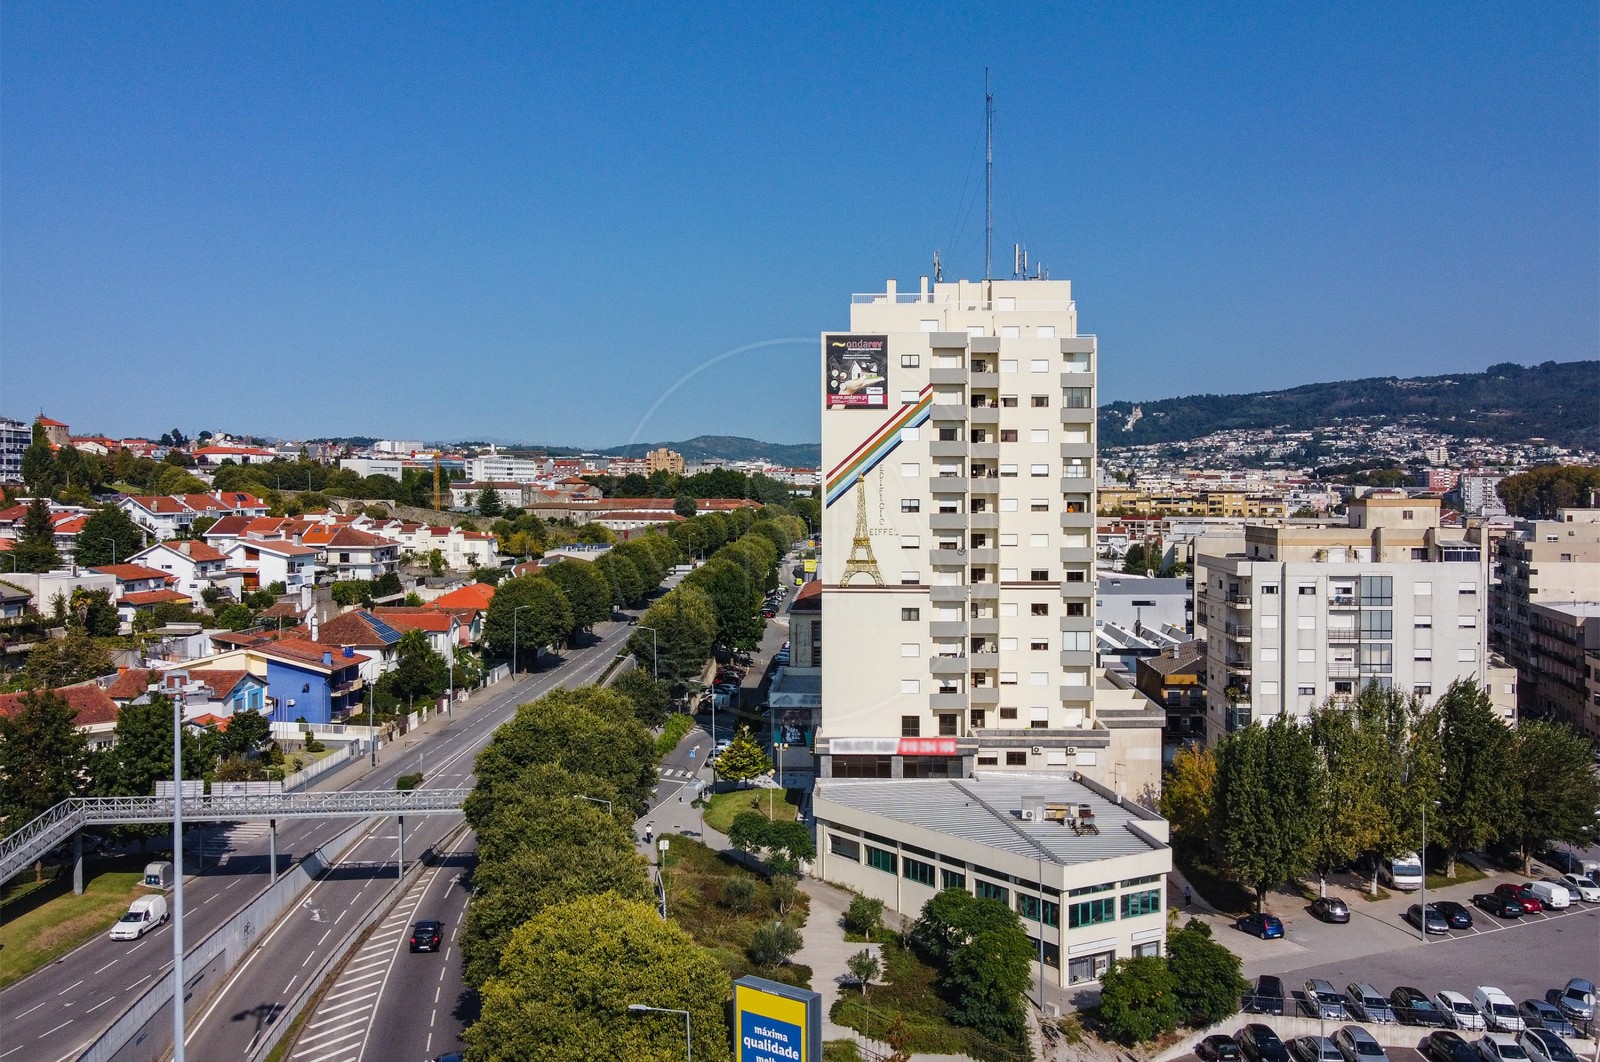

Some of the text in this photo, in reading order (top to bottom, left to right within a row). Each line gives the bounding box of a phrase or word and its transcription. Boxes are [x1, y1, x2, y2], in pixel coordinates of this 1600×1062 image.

[846, 339, 883, 348] ondarev
[869, 528, 899, 536] EIFFEL
[754, 1026, 788, 1042] máxima
[743, 1036, 799, 1060] qualidade
